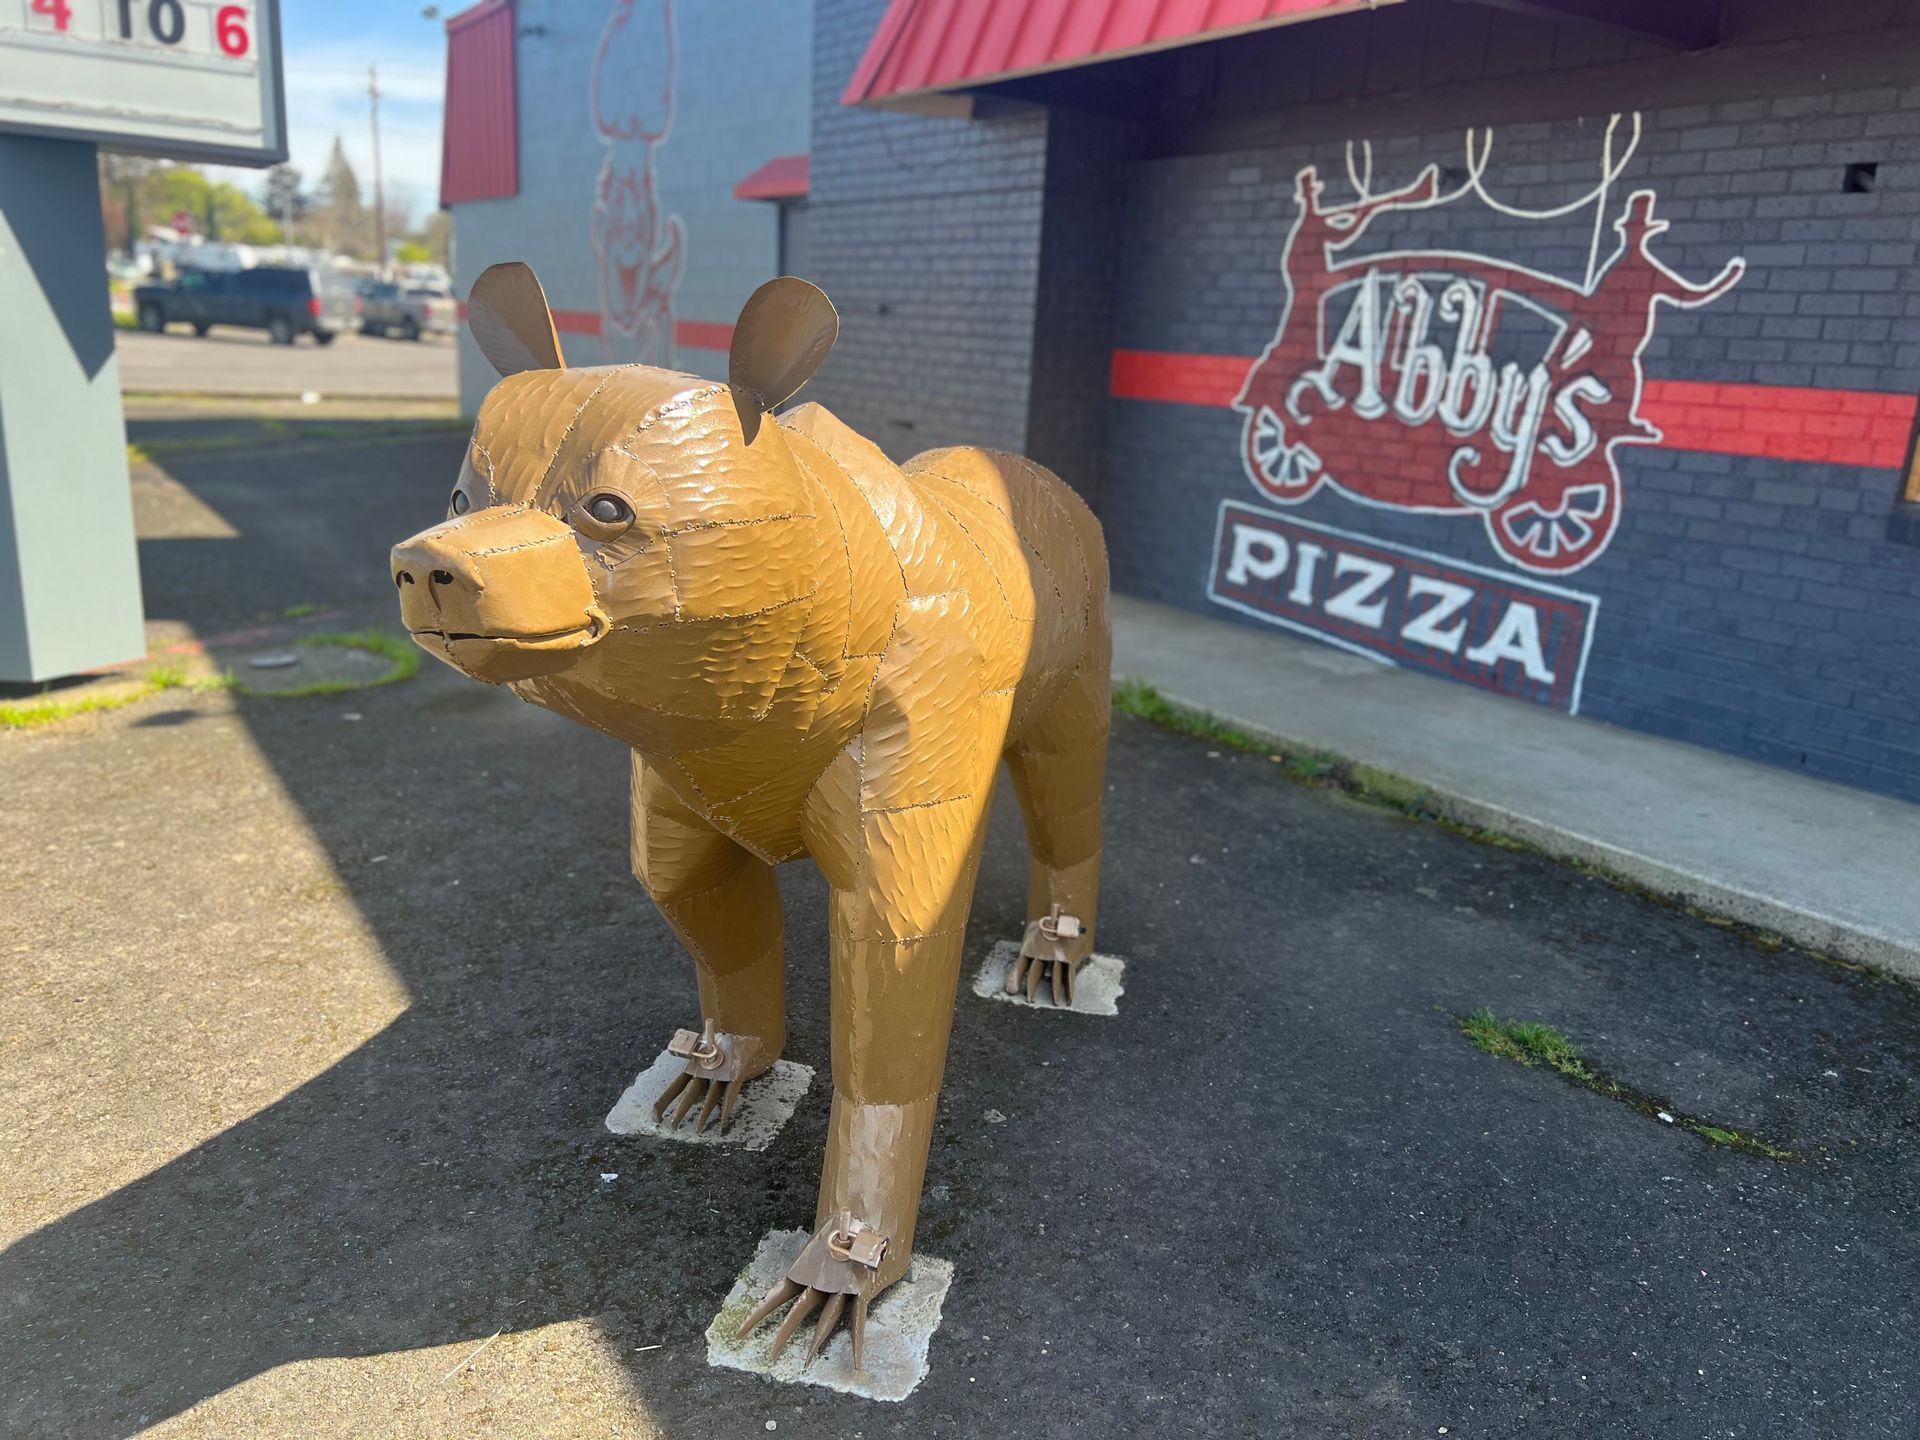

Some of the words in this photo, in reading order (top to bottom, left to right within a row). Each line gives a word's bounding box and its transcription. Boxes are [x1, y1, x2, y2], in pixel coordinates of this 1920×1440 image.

[215, 5, 249, 58] 6
[1287, 268, 1612, 508] Abby's
[1226, 523, 1555, 684] PIZZA
